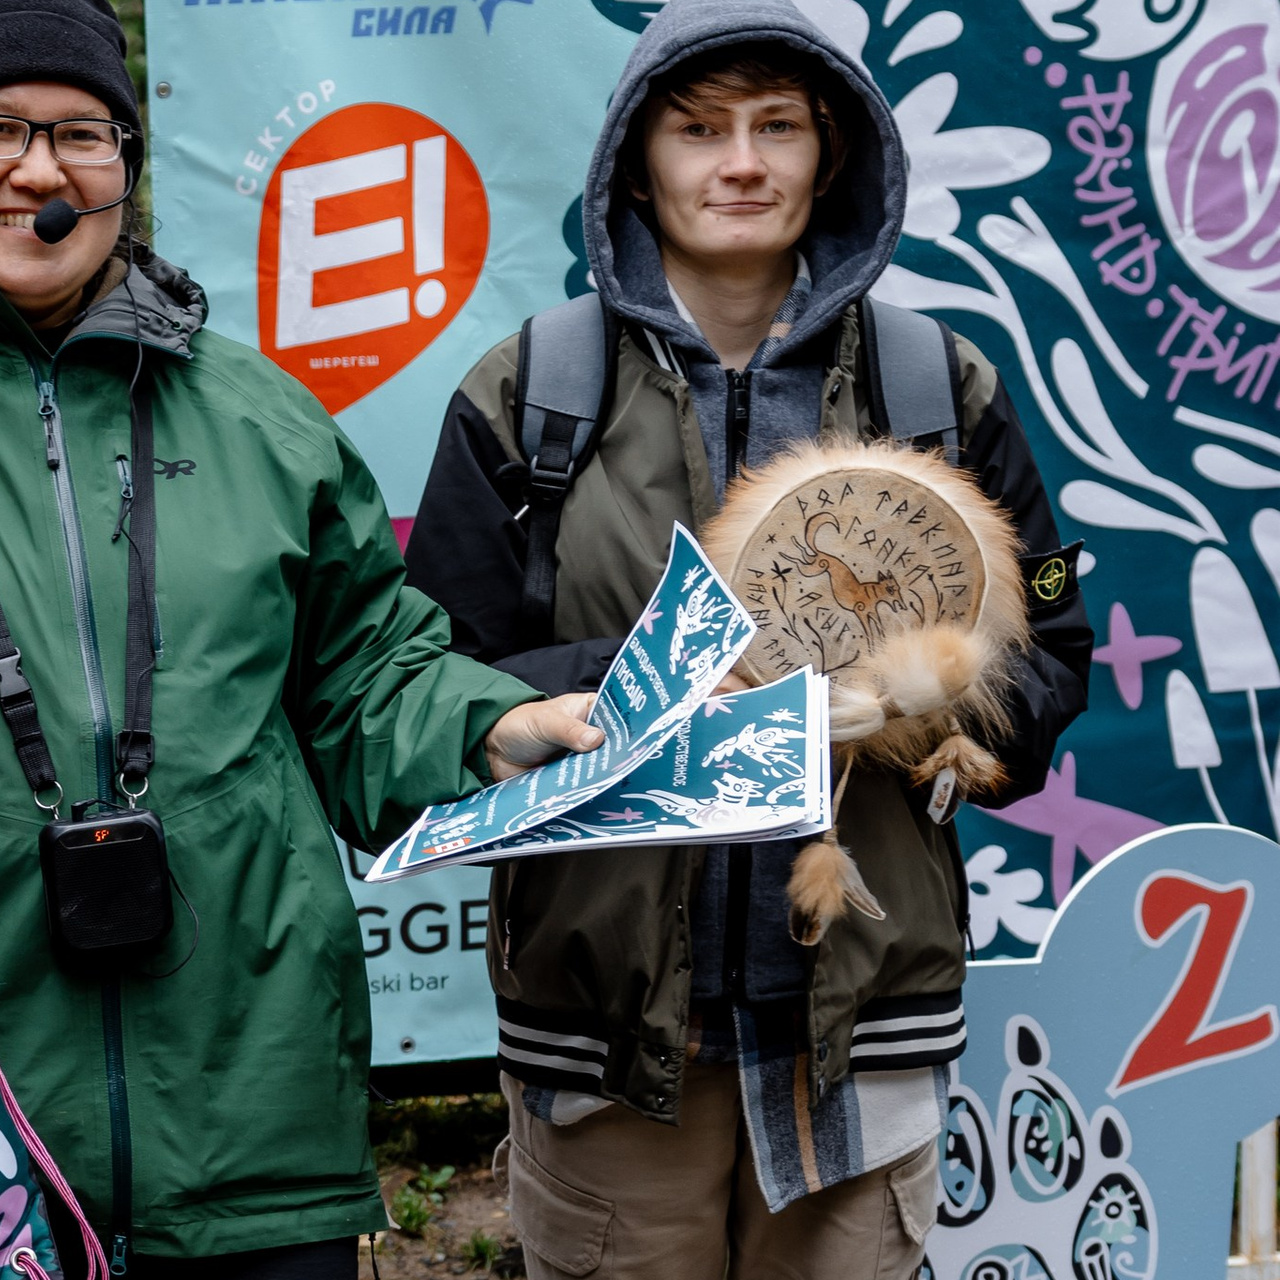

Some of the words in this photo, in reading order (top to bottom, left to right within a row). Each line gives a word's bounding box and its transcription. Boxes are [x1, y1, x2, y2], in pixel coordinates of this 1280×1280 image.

[351, 5, 458, 38] СИЛА
[234, 78, 337, 197] СЕКТОР
[275, 134, 448, 351] Е!
[308, 354, 380, 371] ШЕРЕГЕШ
[410, 972, 450, 993] bar
[1111, 872, 1276, 1094] 2
